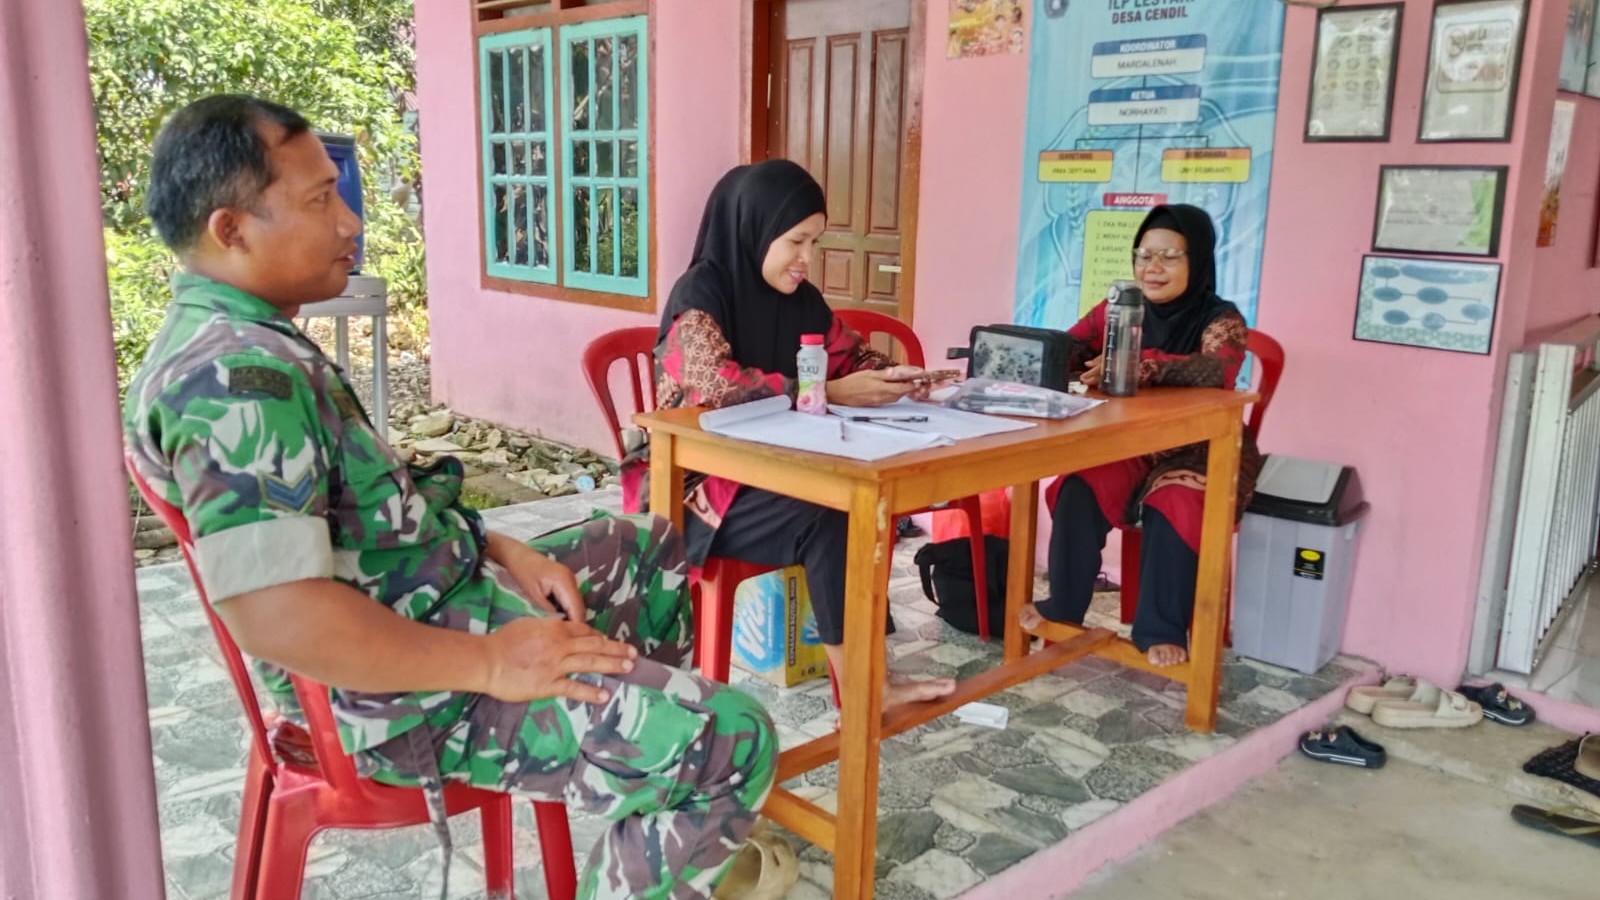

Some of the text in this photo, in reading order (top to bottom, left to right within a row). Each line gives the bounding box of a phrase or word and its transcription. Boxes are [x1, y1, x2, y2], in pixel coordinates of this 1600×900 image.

[1112, 6, 1188, 24] DESA CENDIL
[1119, 39, 1177, 53] KOORDINATOR
[1118, 106, 1167, 117] NORHAYATI
[1113, 195, 1156, 205] ANGGOTA
